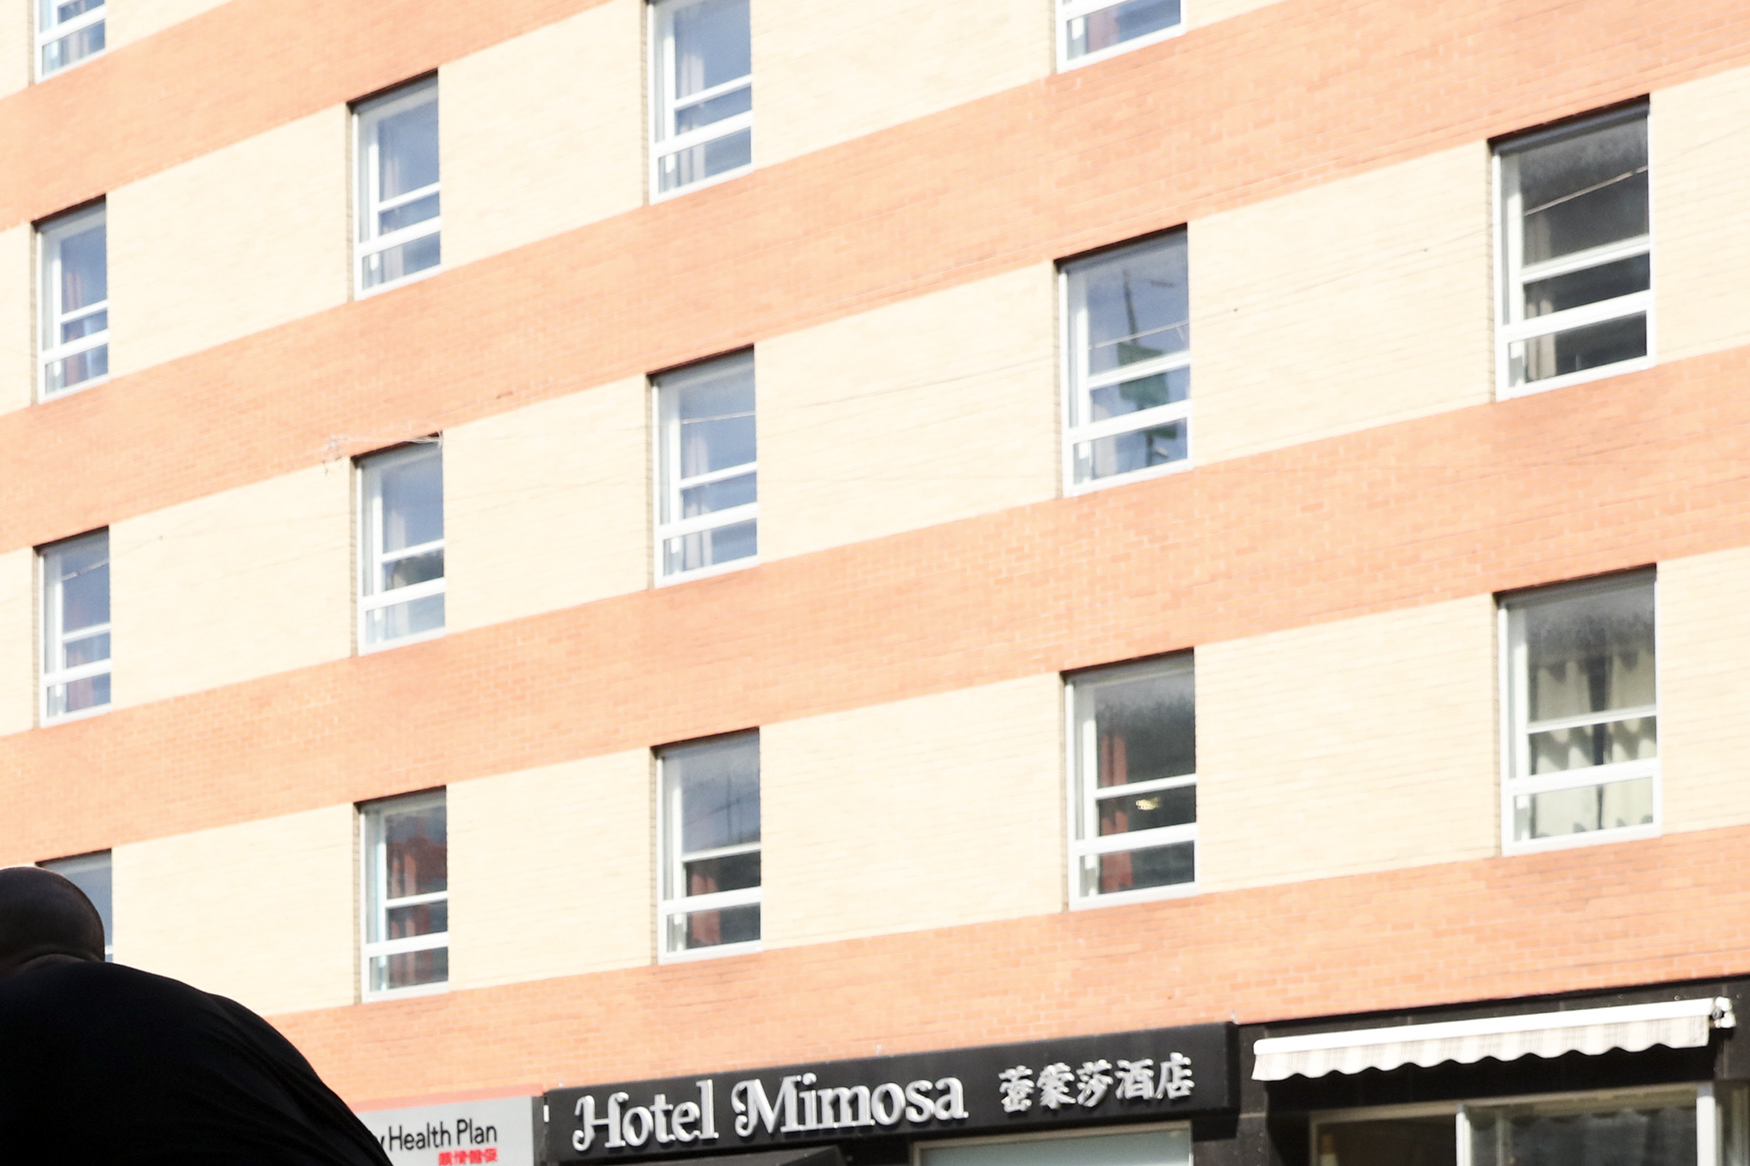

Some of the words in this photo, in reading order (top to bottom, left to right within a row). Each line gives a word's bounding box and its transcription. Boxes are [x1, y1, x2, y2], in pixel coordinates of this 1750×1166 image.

[388, 1120, 452, 1152] Health
[456, 1117, 498, 1146] Plan
[572, 1079, 720, 1152] Hotel
[730, 1071, 969, 1138] Mimosa
